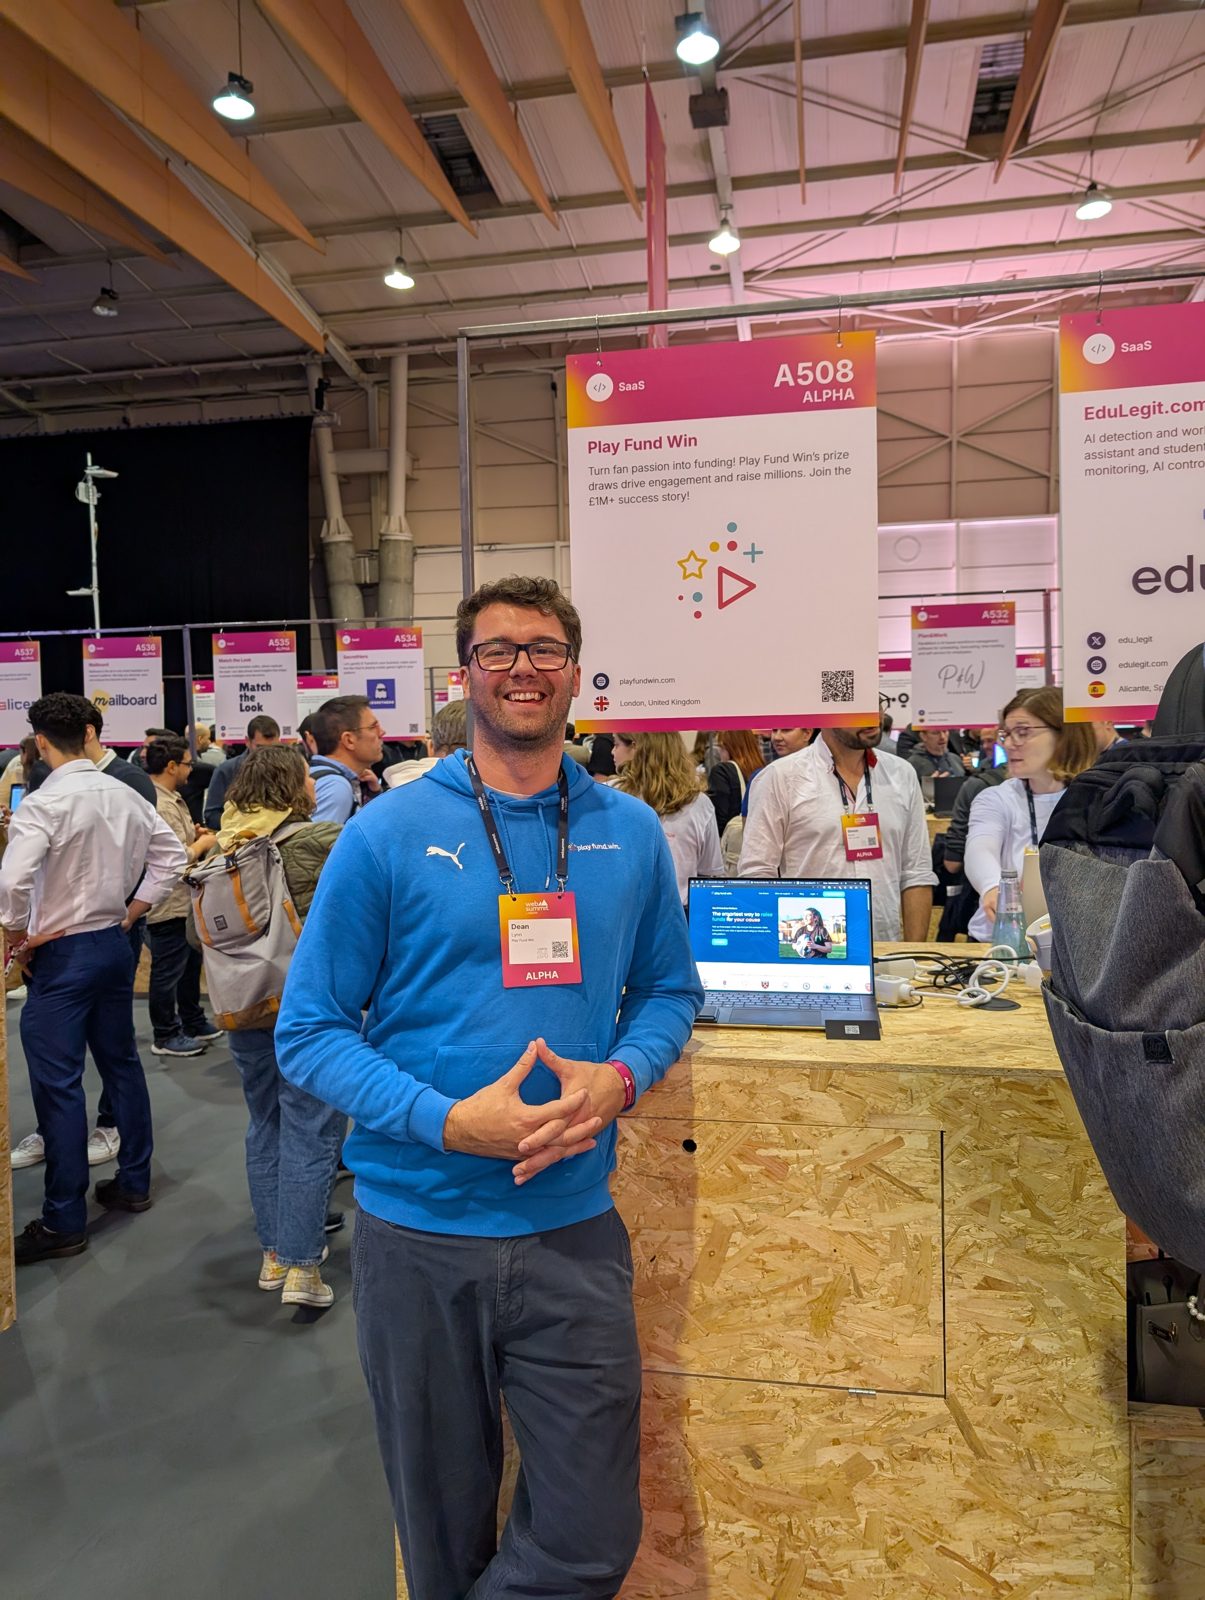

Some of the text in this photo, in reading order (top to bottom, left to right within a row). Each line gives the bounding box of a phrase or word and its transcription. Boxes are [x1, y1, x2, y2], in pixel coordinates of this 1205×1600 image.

[1120, 340, 1152, 353] SaaS
[773, 359, 854, 388] A508
[618, 380, 645, 392] SaaS
[802, 388, 855, 403] ALPHA
[1084, 433, 1096, 444] AI
[1098, 430, 1153, 443] detection
[1156, 427, 1178, 438] and
[587, 433, 698, 455] Play Fund Win
[1084, 447, 1135, 460] assistant
[1137, 445, 1160, 456] and
[588, 466, 610, 476] Turn
[612, 464, 629, 474] fan
[631, 462, 670, 475] passion
[672, 460, 692, 470] into
[694, 457, 736, 469] funding!
[739, 456, 761, 467] Play
[763, 453, 790, 465] Fund
[823, 450, 850, 463] prize
[1084, 463, 1149, 477] monitoring,
[1153, 461, 1164, 472] AI
[588, 466, 852, 491] draws drive engagement and raise millions. Join the
[588, 491, 690, 506] £1M+ success story!
[981, 610, 1009, 619] A532
[268, 638, 290, 647] A535
[394, 634, 417, 642] A534
[1117, 635, 1153, 645] edu_legit
[14, 648, 34, 656] A537
[135, 644, 156, 652] A536
[1118, 660, 1169, 670] edulegit.com
[619, 677, 676, 686] playfundwin.com
[239, 682, 272, 692] Match
[1118, 685, 1152, 693] Alicante,
[93, 693, 157, 706] mailboard
[239, 693, 256, 702] the
[619, 699, 647, 707] London,
[671, 698, 701, 707] Kingdom
[239, 703, 263, 713] Look
[525, 970, 559, 981] ALPHA
